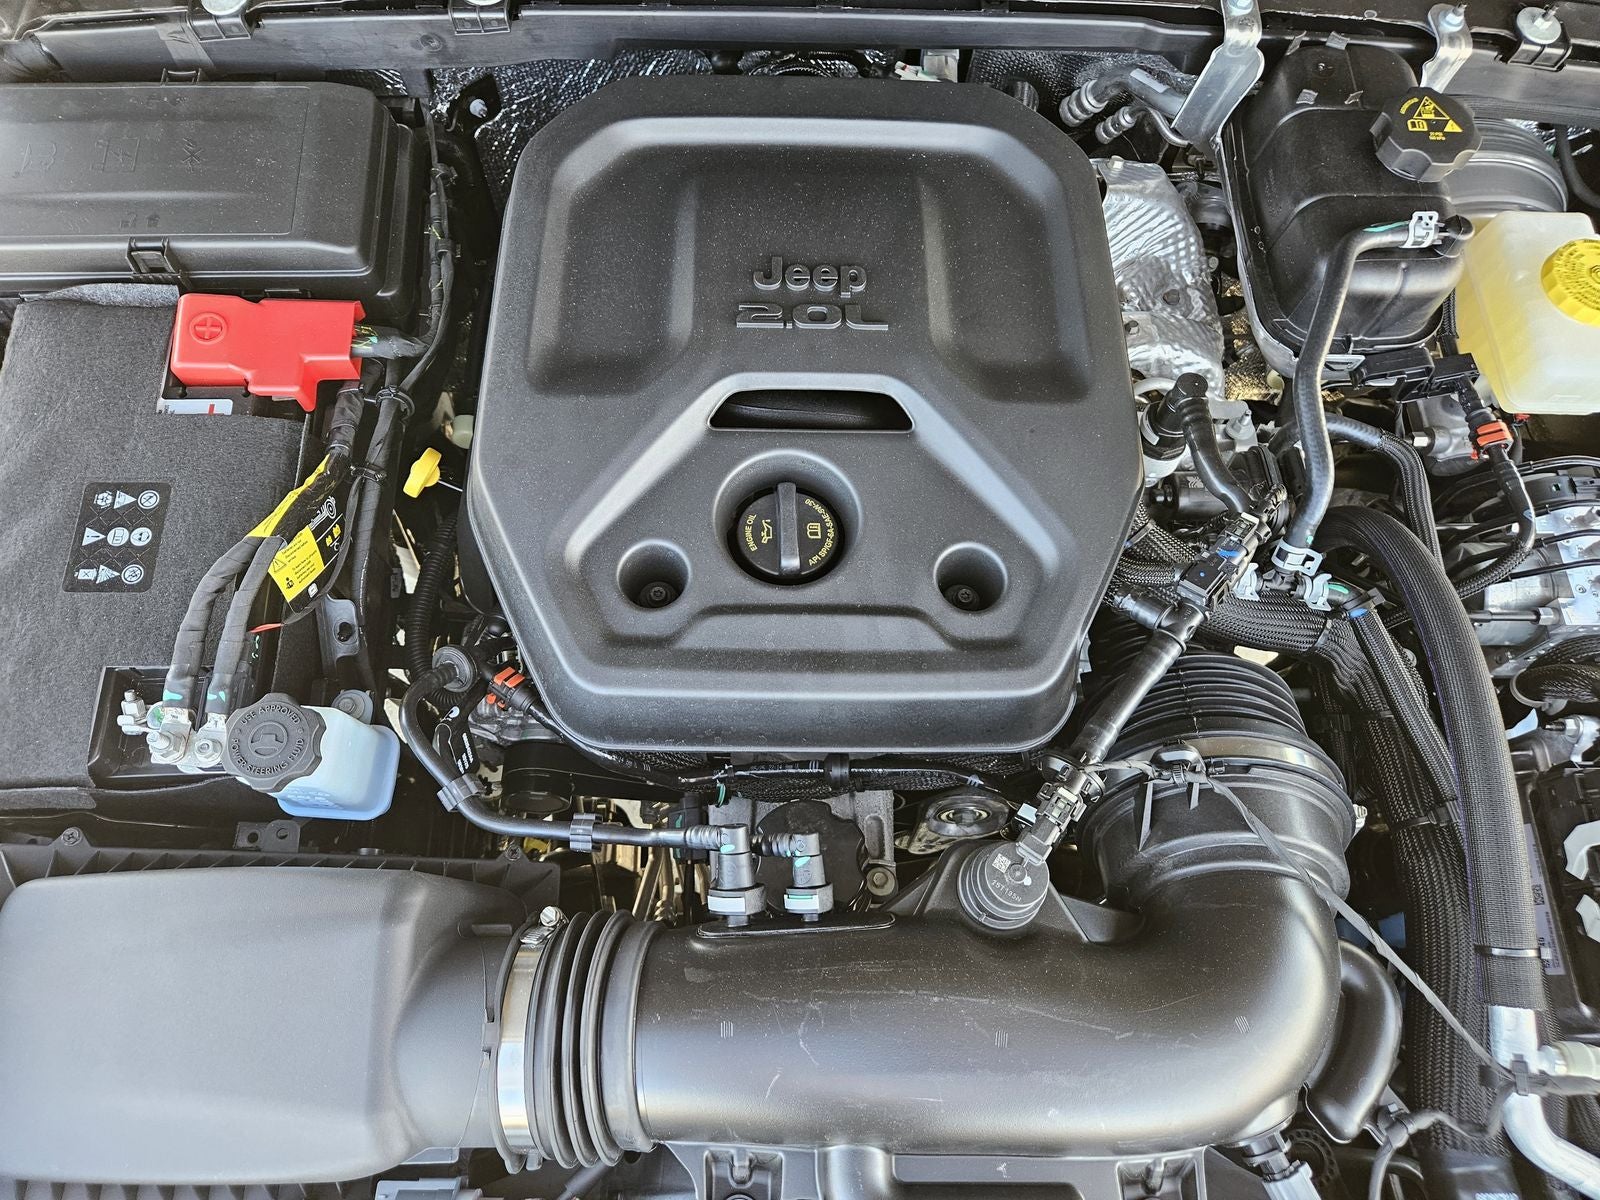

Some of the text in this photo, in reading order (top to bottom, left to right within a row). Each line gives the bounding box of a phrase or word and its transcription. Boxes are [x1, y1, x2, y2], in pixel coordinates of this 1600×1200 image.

[753, 256, 867, 298] Jeep
[736, 302, 889, 330] 2.0L
[745, 514, 758, 552] ENGINE OIL
[808, 554, 821, 566] API
[240, 704, 302, 725] USE APPROVED
[231, 738, 304, 775] POWER STEERING FLUID
